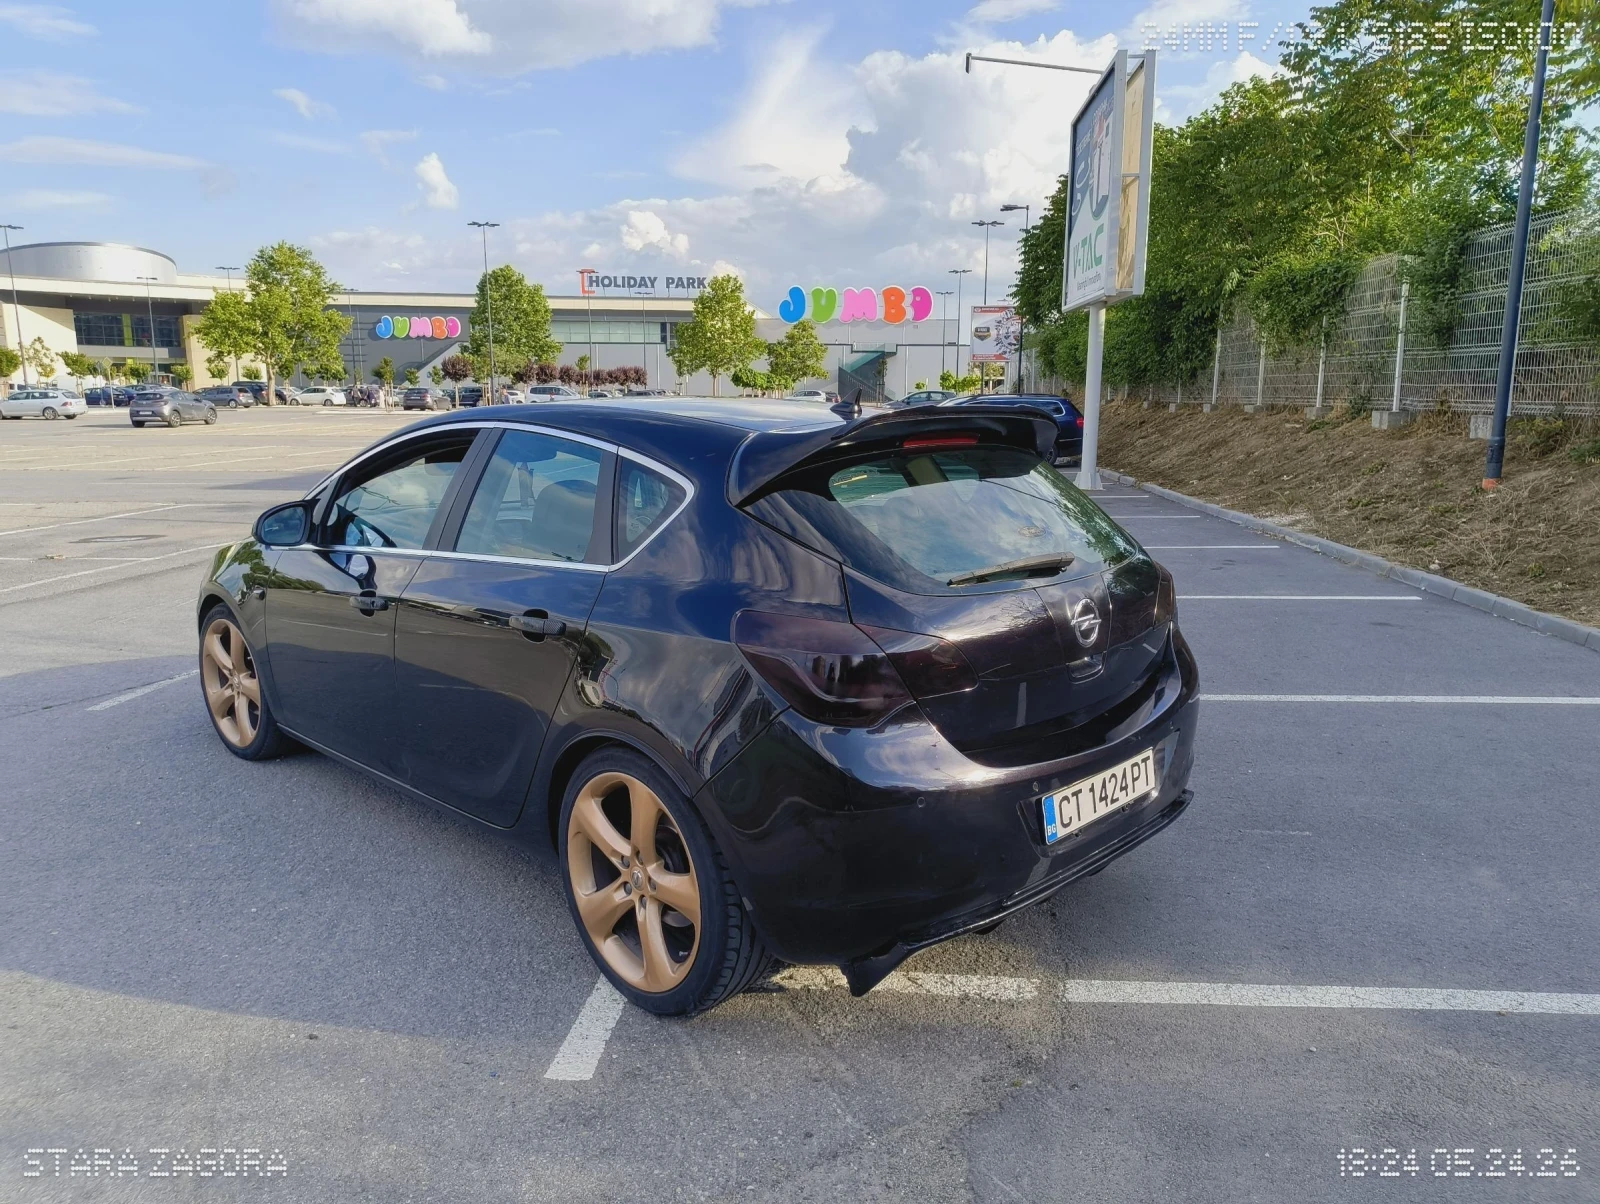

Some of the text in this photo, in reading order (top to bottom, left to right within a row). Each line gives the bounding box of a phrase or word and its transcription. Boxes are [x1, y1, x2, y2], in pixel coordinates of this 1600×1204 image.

[1073, 222, 1104, 279] V-TAC
[588, 275, 707, 289] HOLIDAY PARK
[778, 285, 934, 324] JUMBO
[375, 315, 462, 340] JUMBO
[1058, 788, 1083, 829] CT
[1046, 823, 1057, 836] BG
